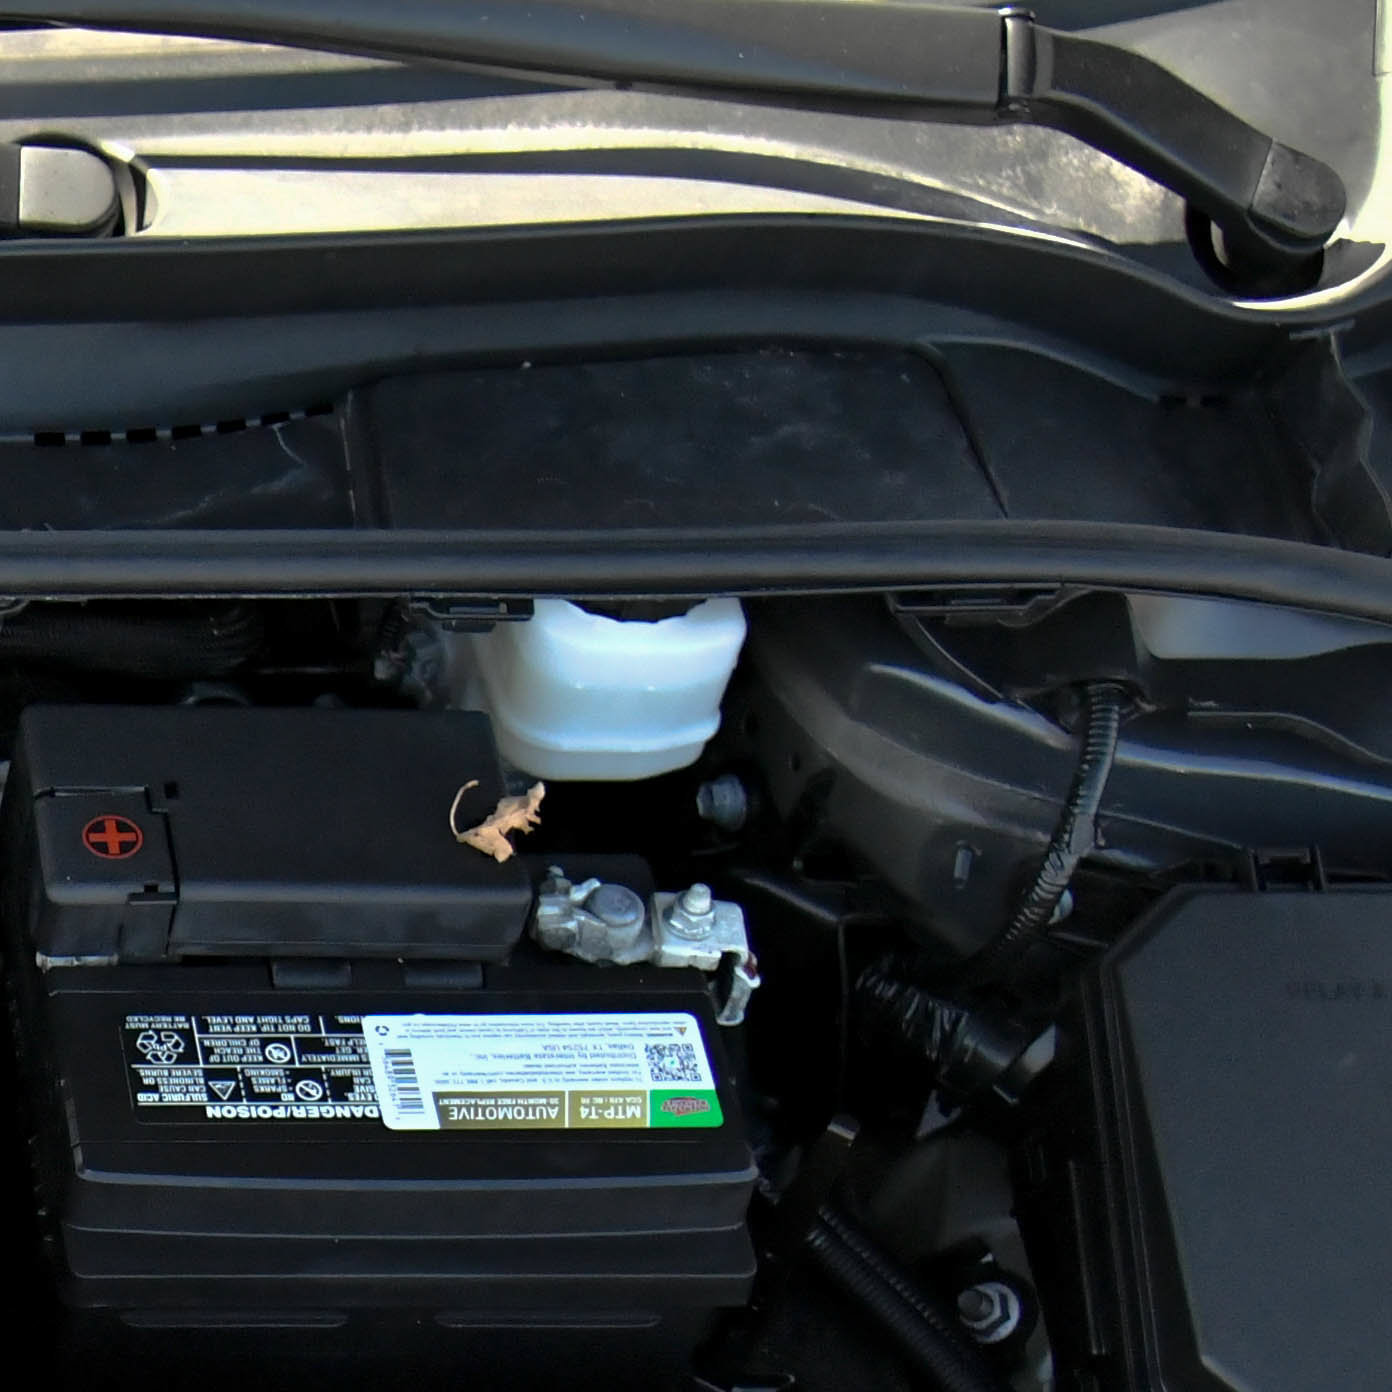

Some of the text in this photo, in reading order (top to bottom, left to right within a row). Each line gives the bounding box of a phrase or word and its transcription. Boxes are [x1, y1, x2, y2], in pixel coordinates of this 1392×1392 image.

[208, 1024, 232, 1032] VENT
[234, 1024, 256, 1032] KEEP
[277, 1024, 294, 1032] NOT
[297, 1024, 311, 1032] DO
[209, 1054, 264, 1062] KEEP OUT OF
[302, 1054, 359, 1062] IMMEDIATELY
[137, 1093, 208, 1101] SULFURIC ACID
[205, 1105, 379, 1118] DANGER/POISON
[448, 1106, 559, 1120] AUTOMOTIVE
[580, 1105, 642, 1119] MTP-T4
